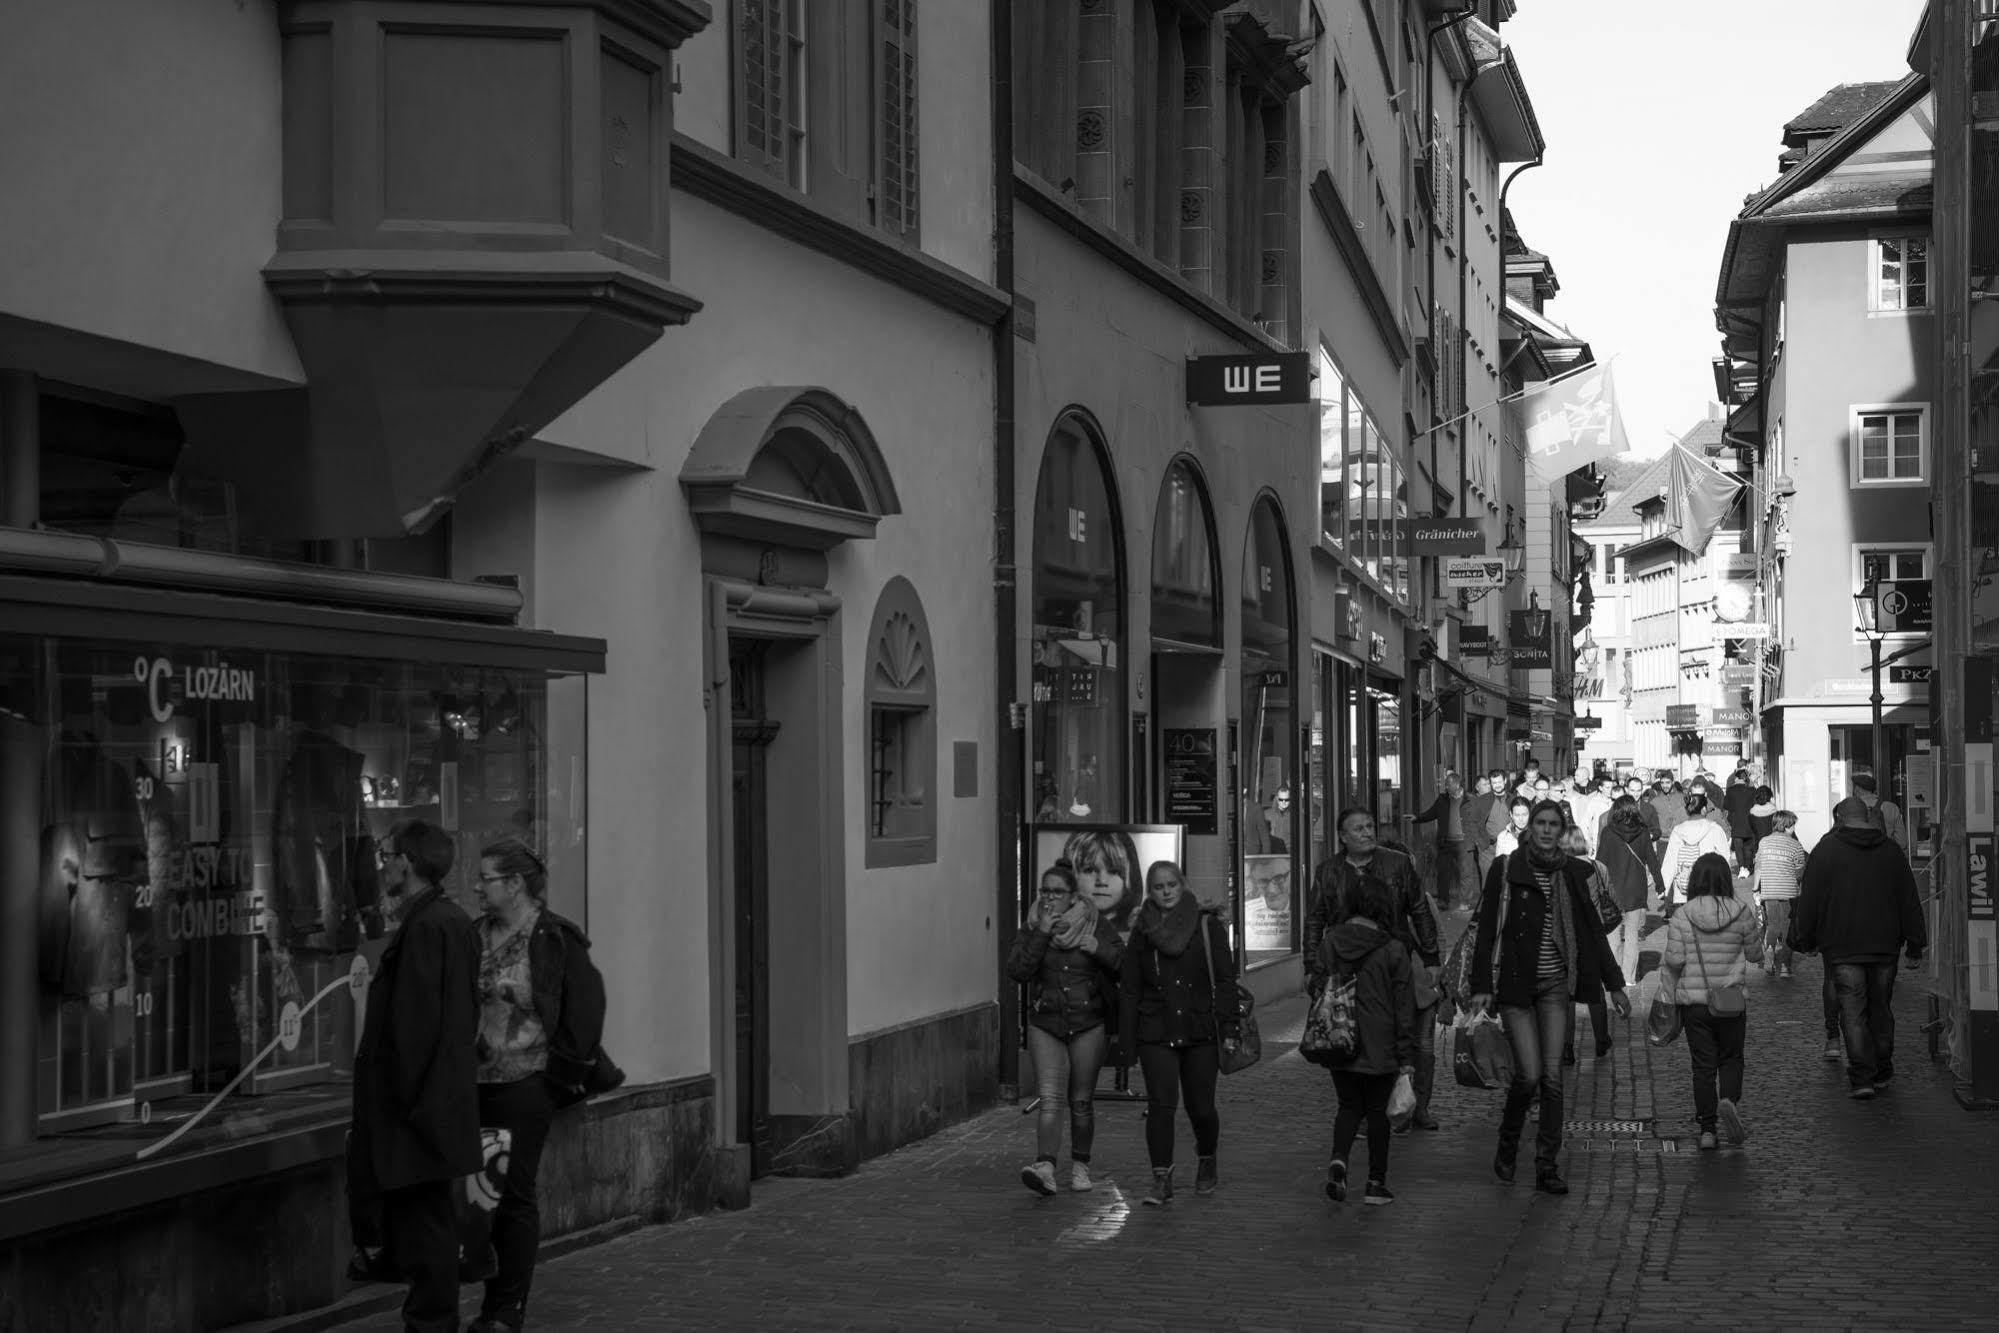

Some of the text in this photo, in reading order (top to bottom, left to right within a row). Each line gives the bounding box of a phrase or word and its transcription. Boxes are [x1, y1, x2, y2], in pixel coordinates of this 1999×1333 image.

[1224, 365, 1281, 393] WE
[1416, 528, 1479, 540] Gränicher
[1729, 626, 1766, 635] OMEGA
[186, 662, 254, 701] LOZÄRN
[1574, 678, 1604, 698] H&M
[1707, 744, 1740, 752] MANOR
[136, 777, 153, 800] 30
[168, 846, 221, 889] EASY
[1970, 837, 1994, 915] Lawil
[136, 885, 152, 908] 20
[136, 992, 152, 1016] 10
